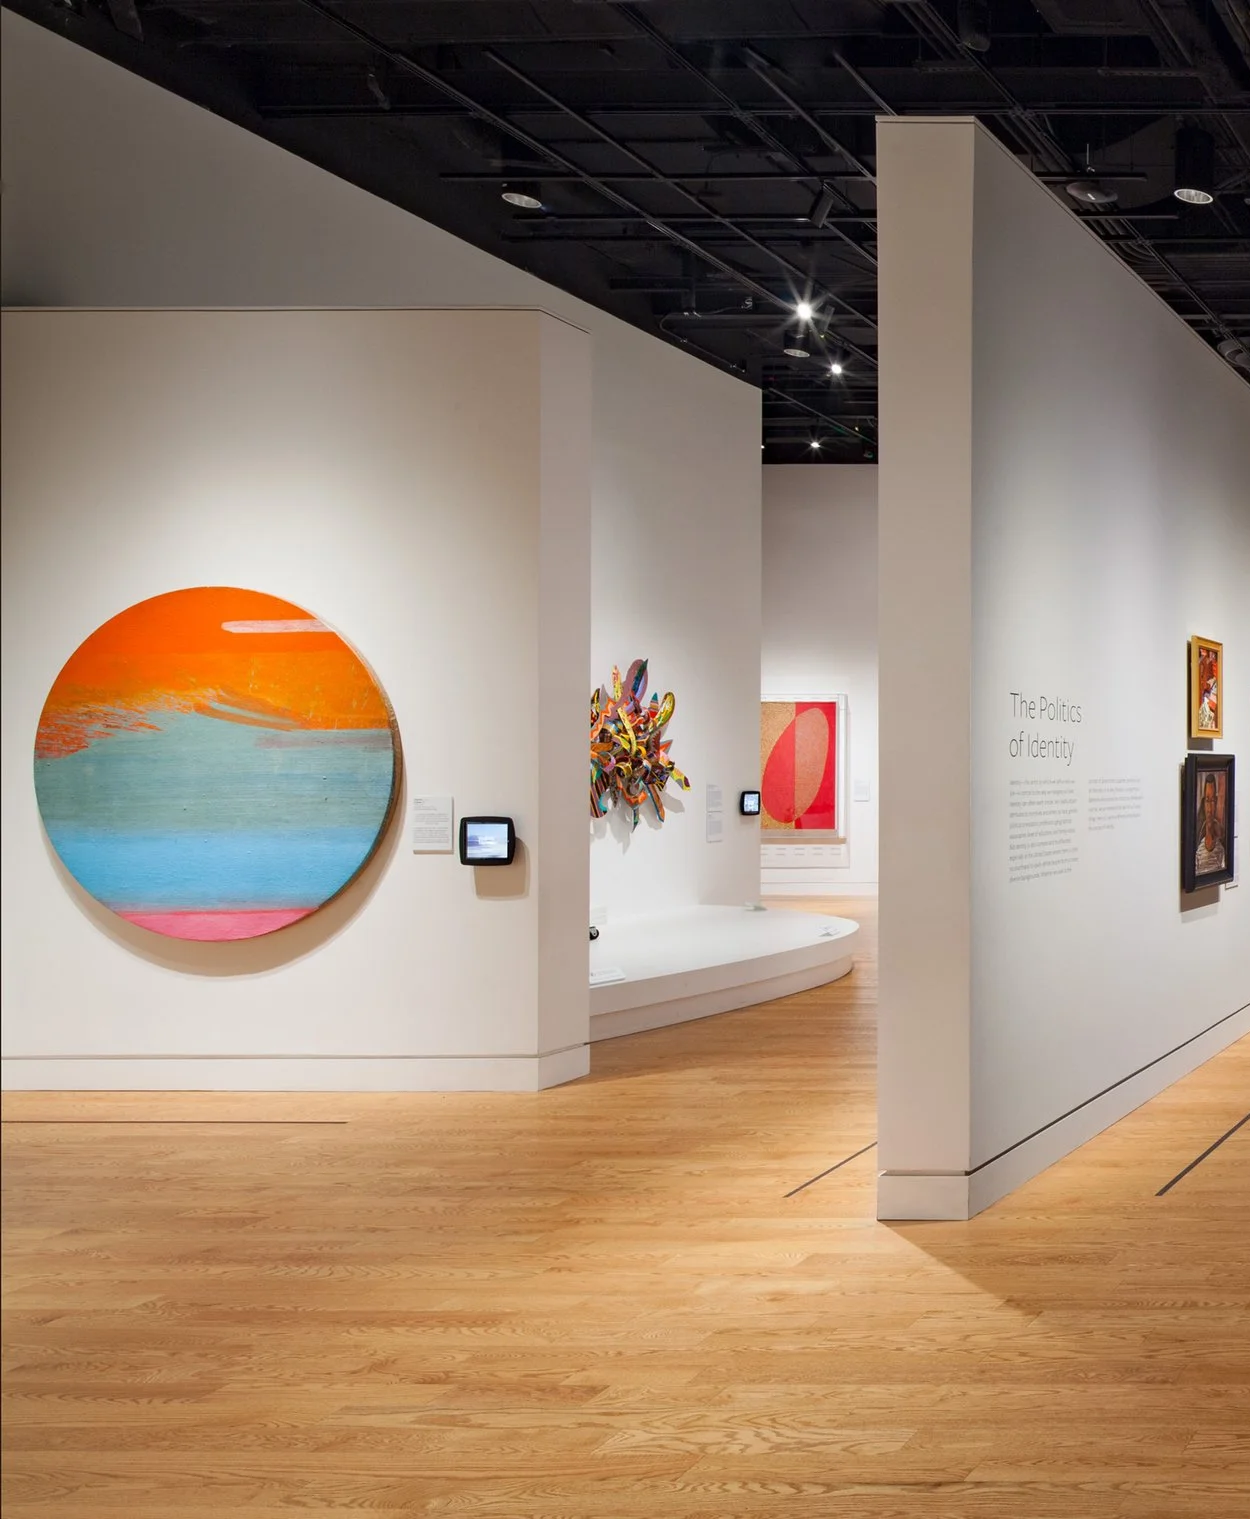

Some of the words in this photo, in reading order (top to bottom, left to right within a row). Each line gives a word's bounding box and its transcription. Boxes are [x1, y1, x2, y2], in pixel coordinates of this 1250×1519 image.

[1009, 692, 1036, 719] The
[1040, 696, 1082, 723] Politics
[1009, 730, 1024, 757] of
[1027, 732, 1075, 767] Identity
